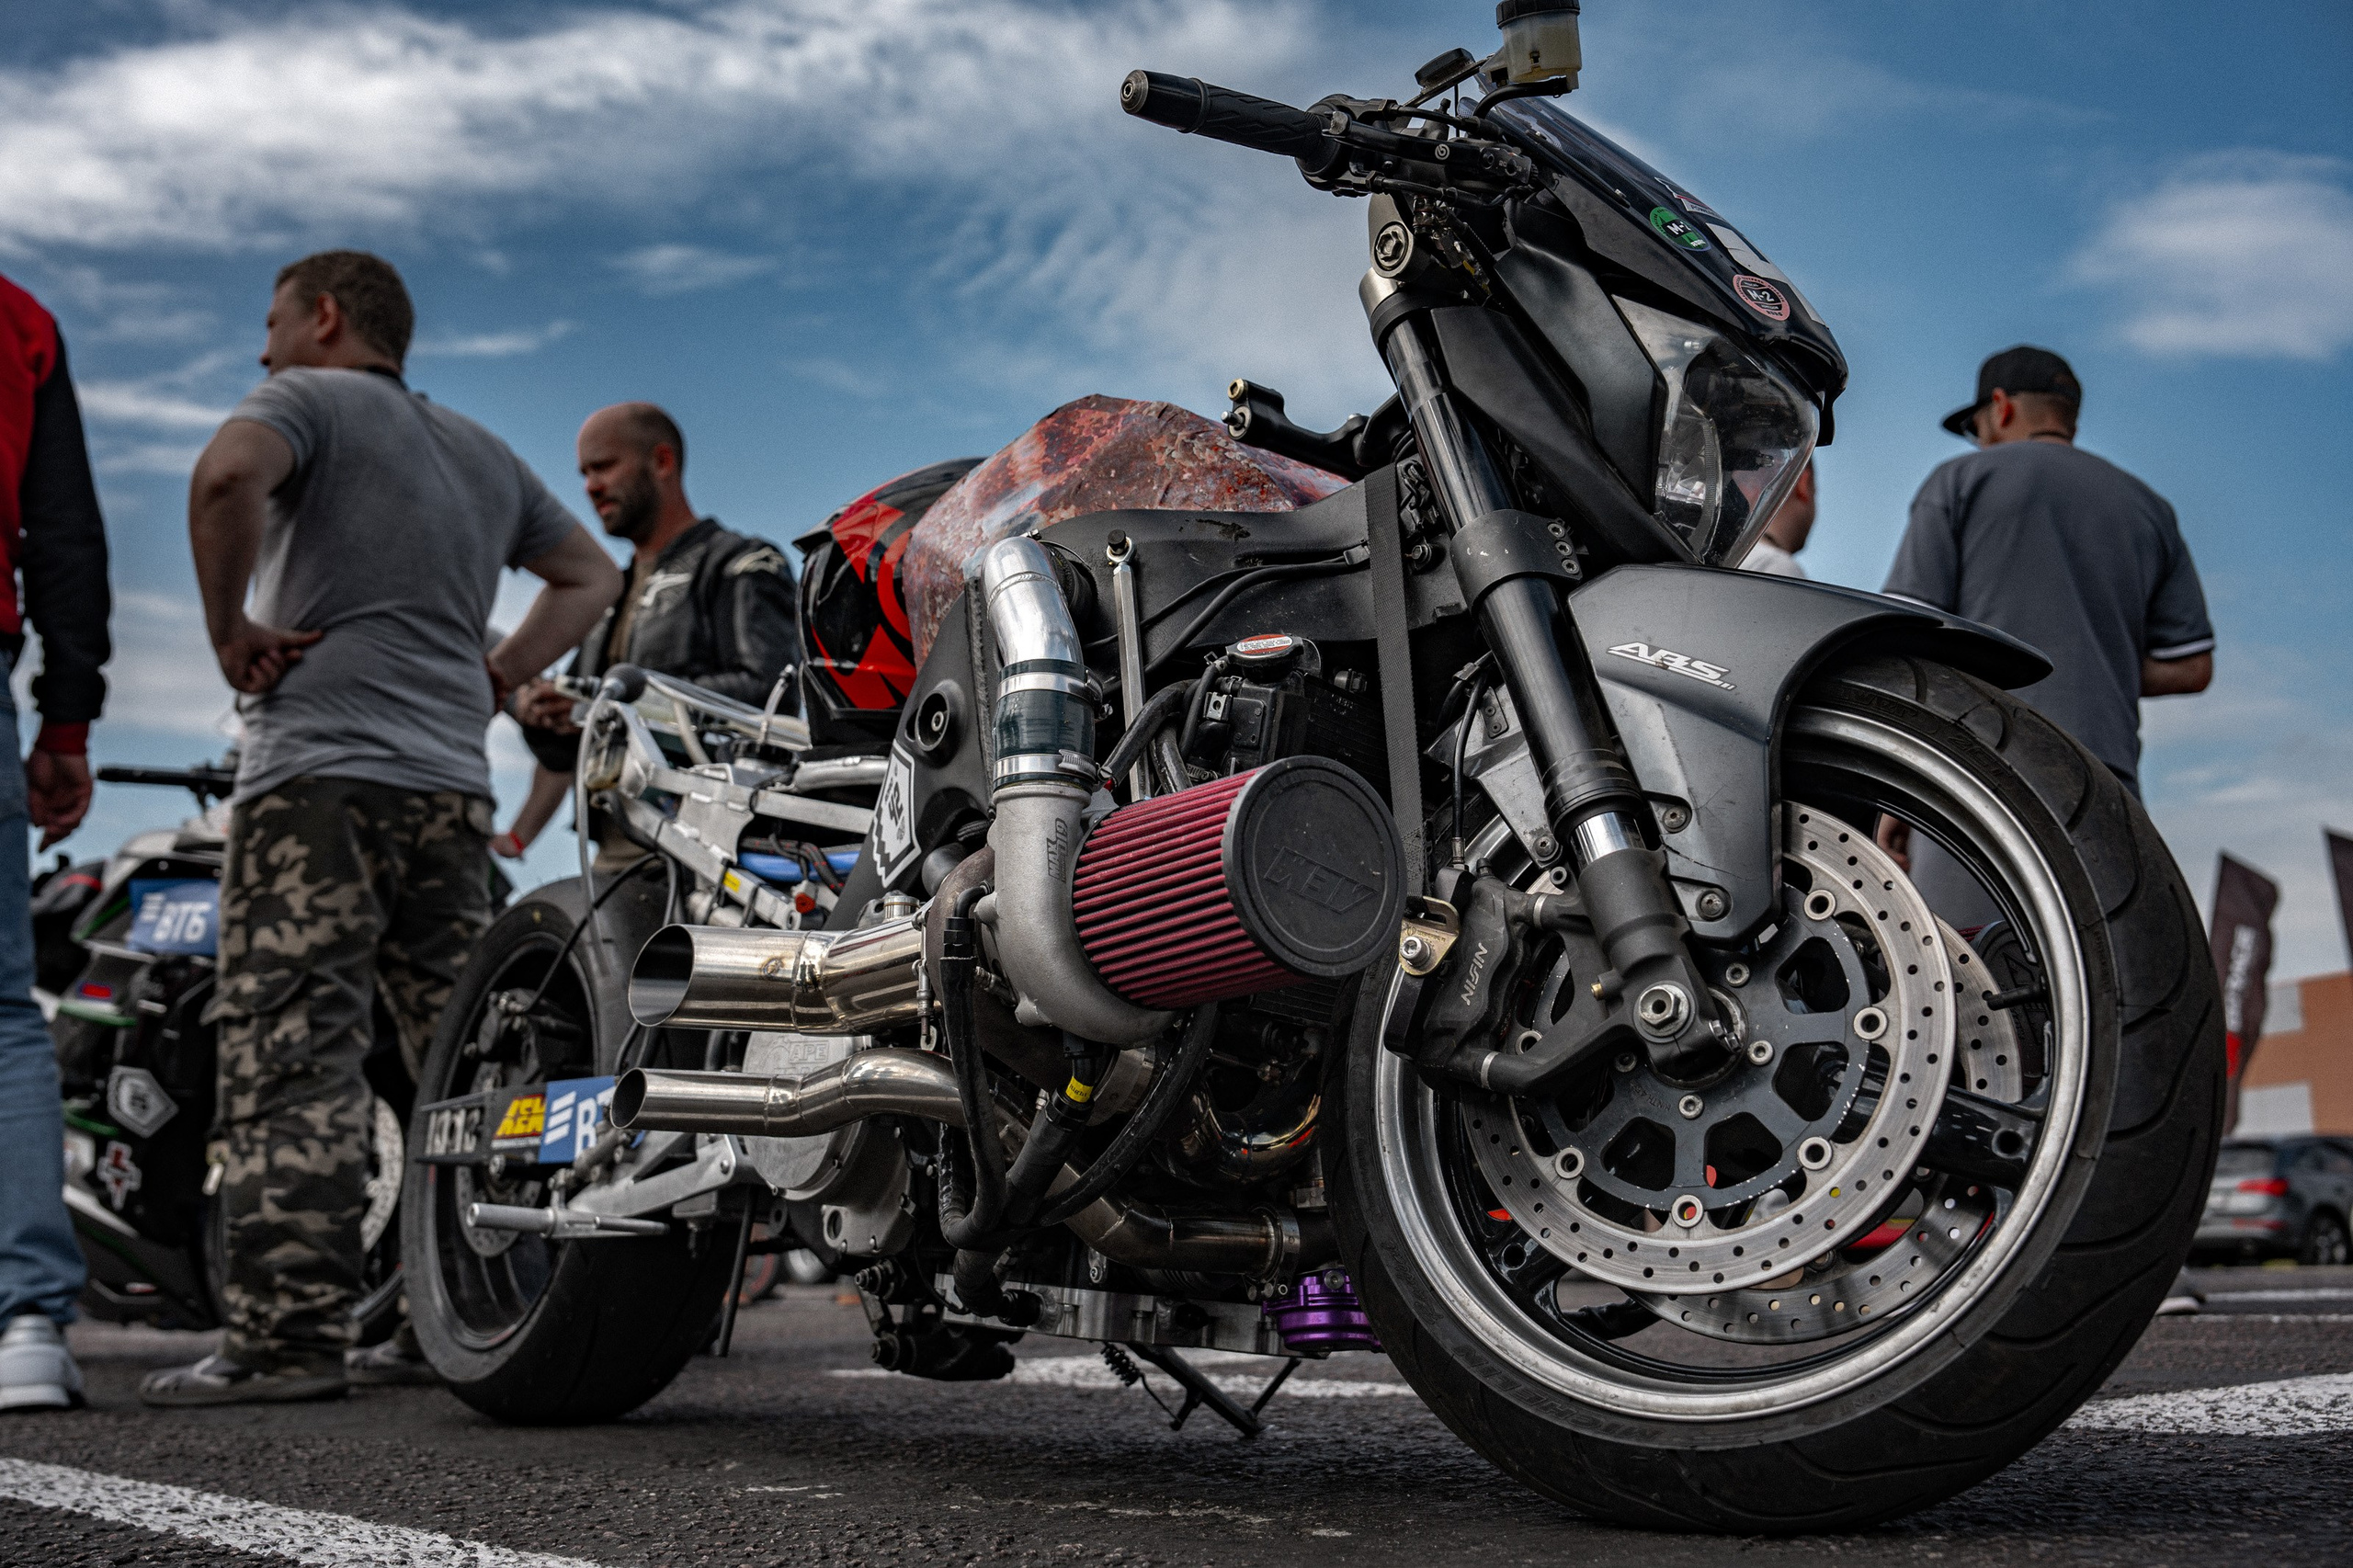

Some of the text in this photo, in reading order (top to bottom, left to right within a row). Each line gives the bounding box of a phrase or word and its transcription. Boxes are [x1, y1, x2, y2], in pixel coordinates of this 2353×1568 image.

[1608, 642, 1731, 682] ABS
[790, 1043, 826, 1062] APE
[1450, 1344, 1664, 1443] MICHELIN
